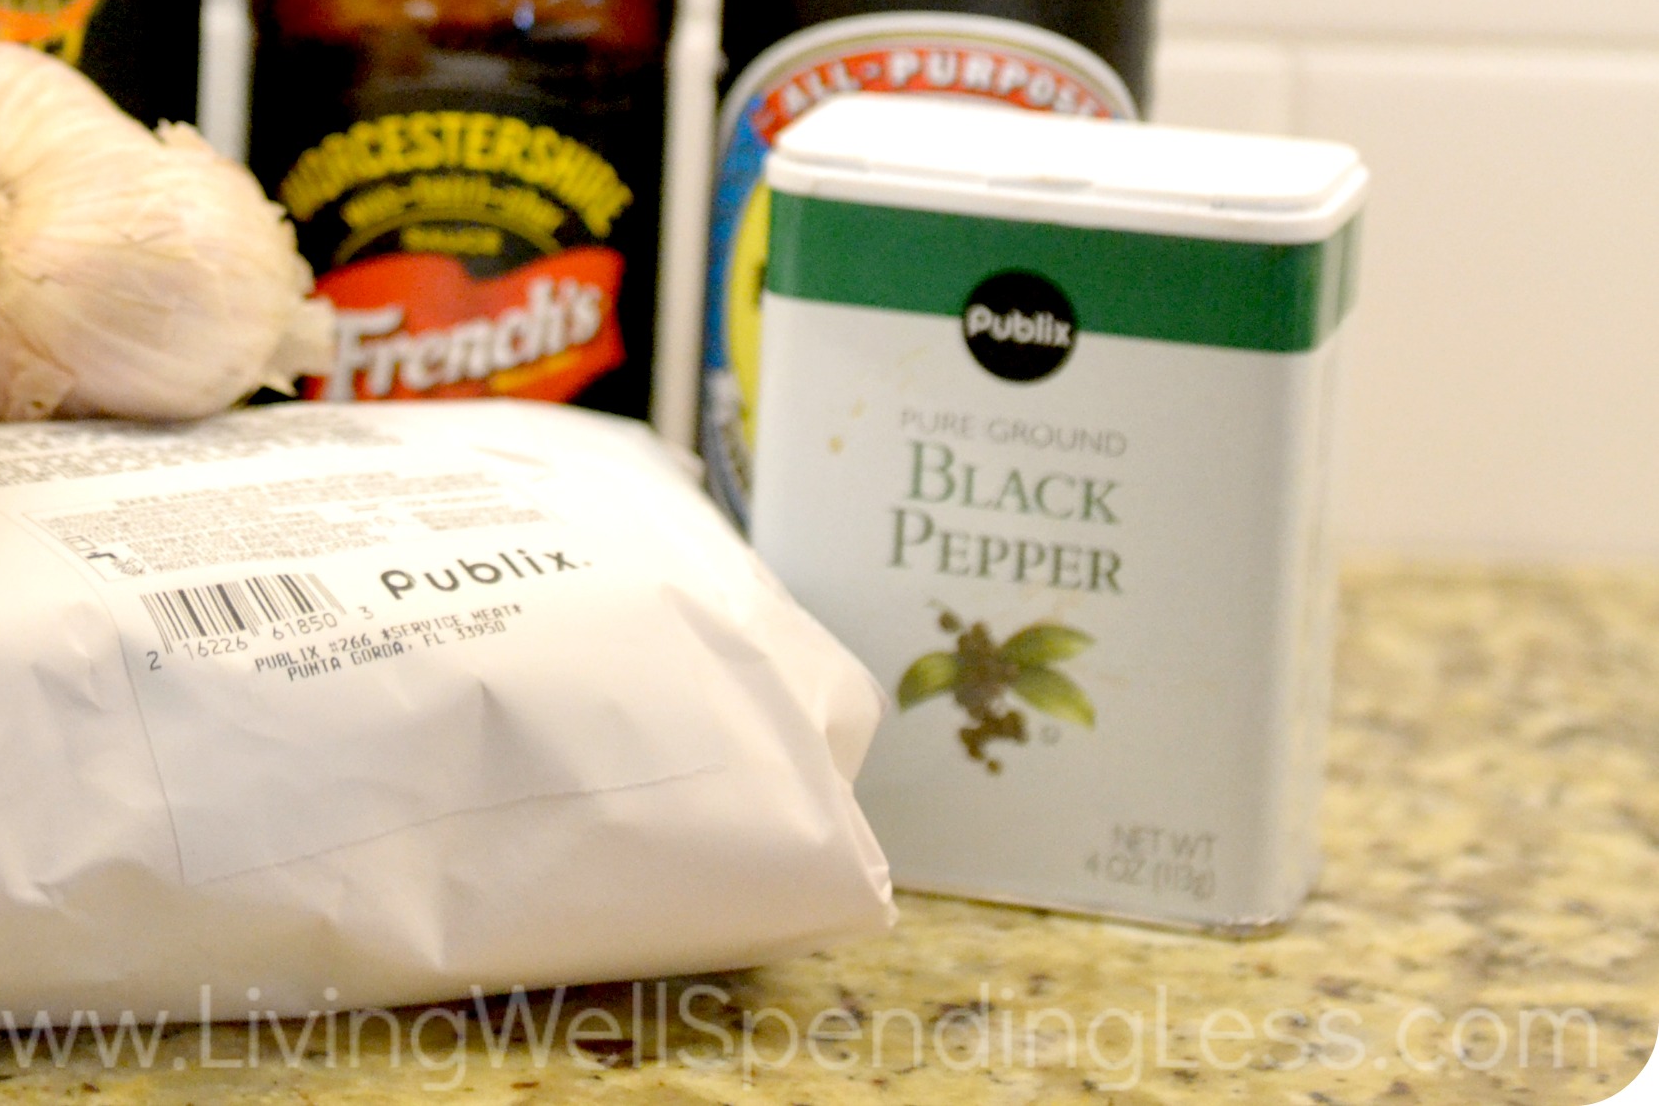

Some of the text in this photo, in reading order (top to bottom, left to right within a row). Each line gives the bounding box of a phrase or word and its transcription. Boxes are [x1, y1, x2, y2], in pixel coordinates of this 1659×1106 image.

[966, 304, 1073, 348] Publix
[901, 407, 1128, 458] PURE GROUND
[907, 441, 1120, 525] BLACK
[379, 548, 576, 600] Publix
[886, 507, 1124, 594] PEPPER
[182, 636, 249, 662] 16226
[271, 612, 339, 642] 61850
[254, 646, 322, 673] PUBLIX
[329, 633, 373, 652] #266
[287, 656, 343, 681] PUNTA
[423, 632, 448, 648] FL
[455, 620, 508, 642] 33950
